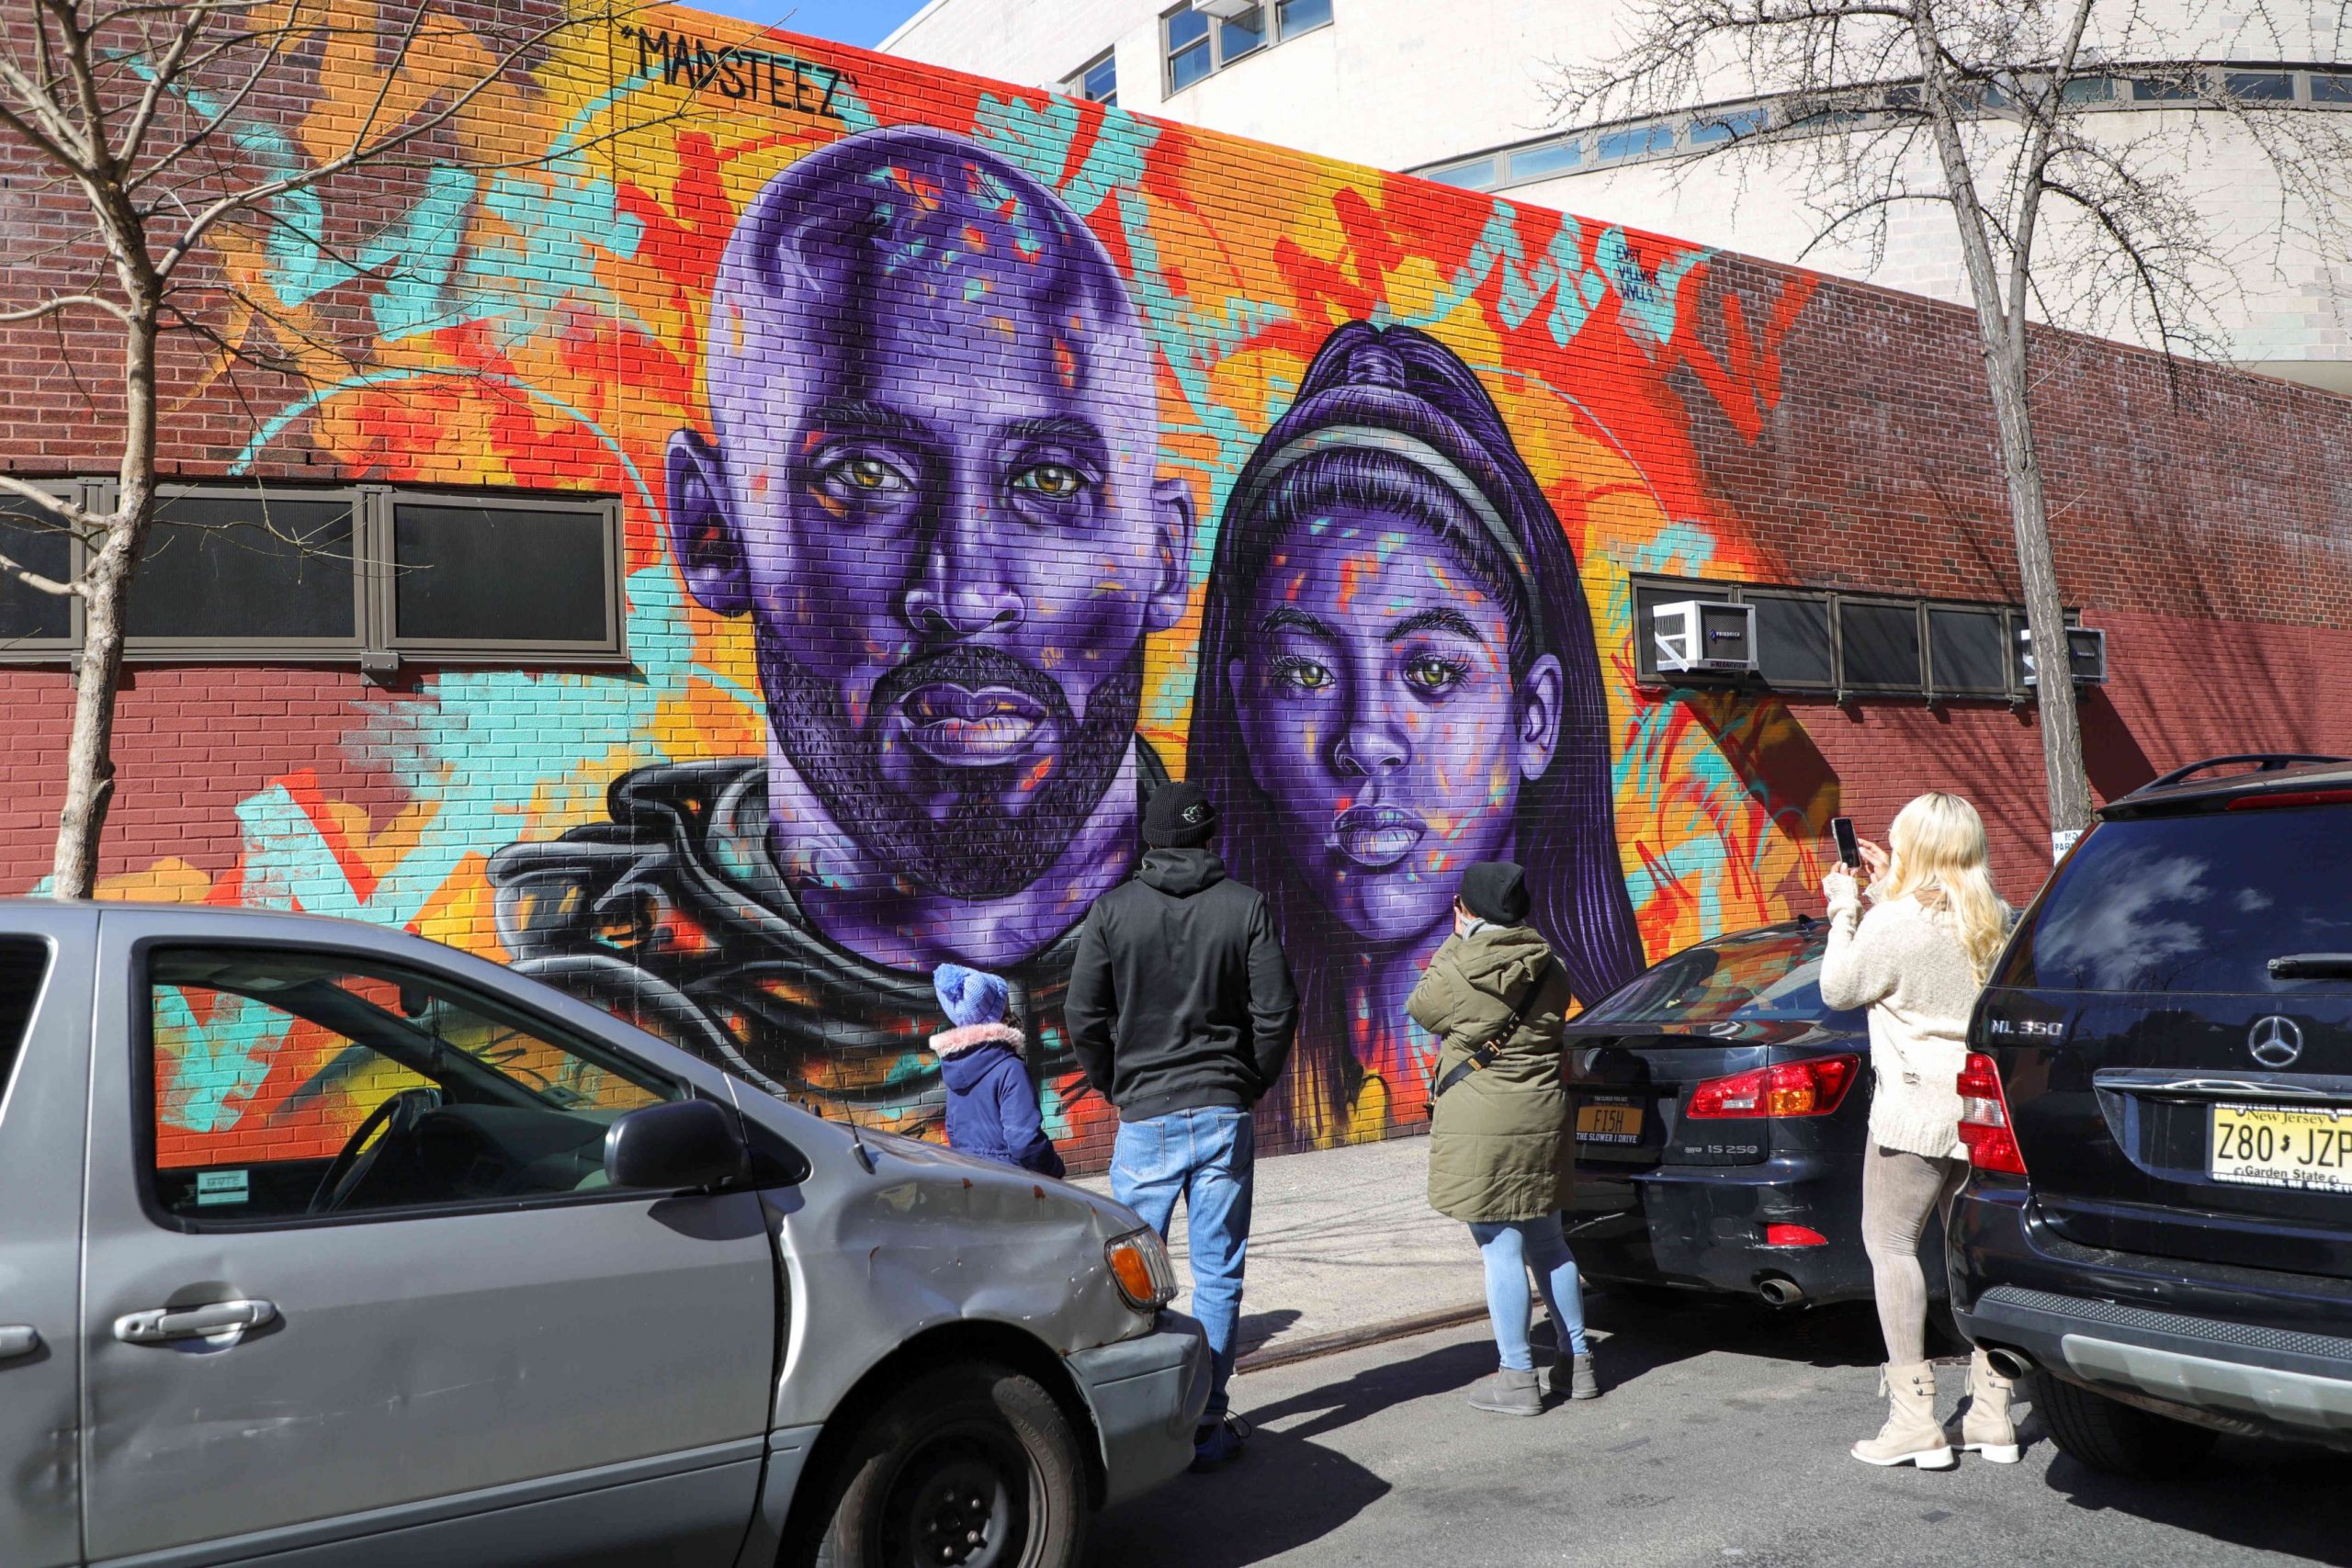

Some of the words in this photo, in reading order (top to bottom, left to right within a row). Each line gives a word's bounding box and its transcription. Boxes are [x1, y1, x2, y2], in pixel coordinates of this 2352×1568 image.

[1991, 1019, 2015, 1033] ML
[2018, 1020, 2064, 1036] 350
[2247, 1109, 2278, 1122] New
[2281, 1111, 2326, 1126] Jersey
[1577, 1132, 1588, 1141] THE
[1589, 1133, 1613, 1142] SLOWER
[1618, 1135, 1637, 1144] DRIVE
[2218, 1122, 2273, 1162] Z80
[2297, 1128, 2352, 1168] JZP
[1708, 1145, 1723, 1154] IS
[1725, 1145, 1758, 1154] 250
[2245, 1166, 2288, 1179] Garden
[2293, 1168, 2326, 1181] State
